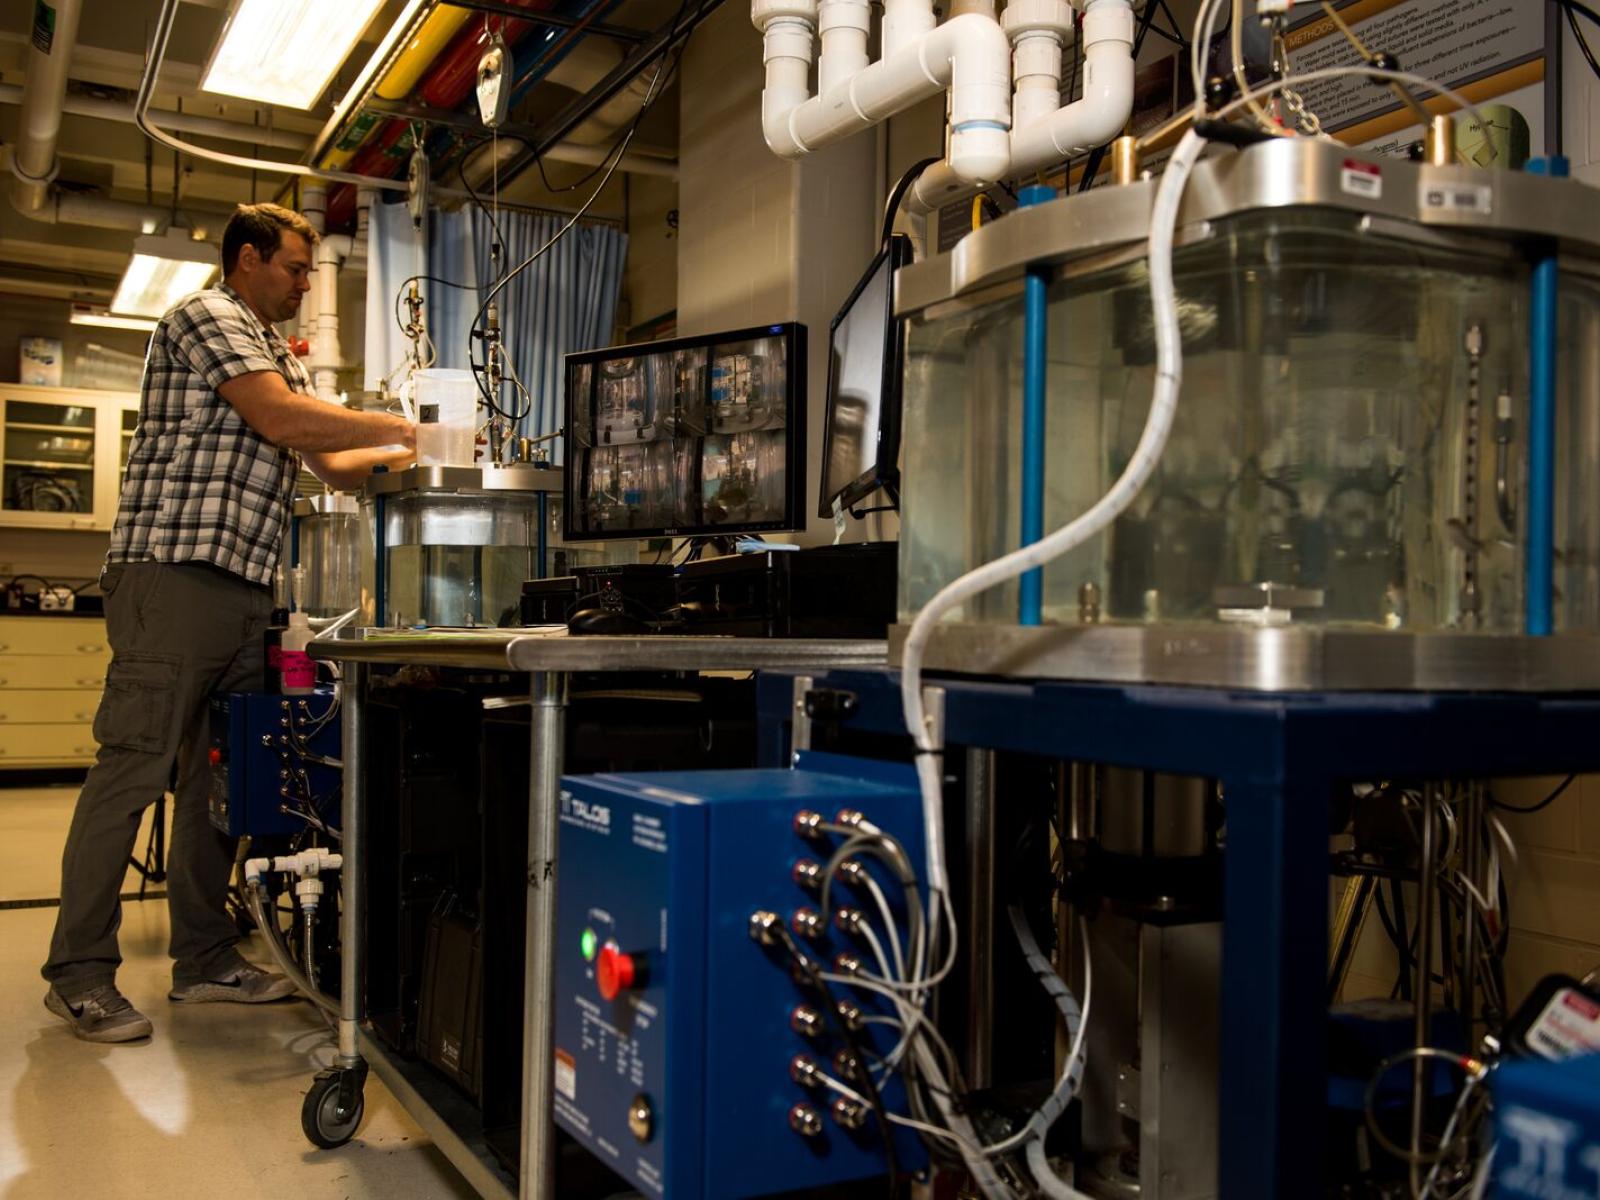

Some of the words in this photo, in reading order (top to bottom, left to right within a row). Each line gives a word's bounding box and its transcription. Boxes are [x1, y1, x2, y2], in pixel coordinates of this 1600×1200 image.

[1289, 22, 1334, 48] METHODS
[1432, 46, 1457, 62] different
[1459, 39, 1473, 51] time
[1460, 60, 1469, 71] UV
